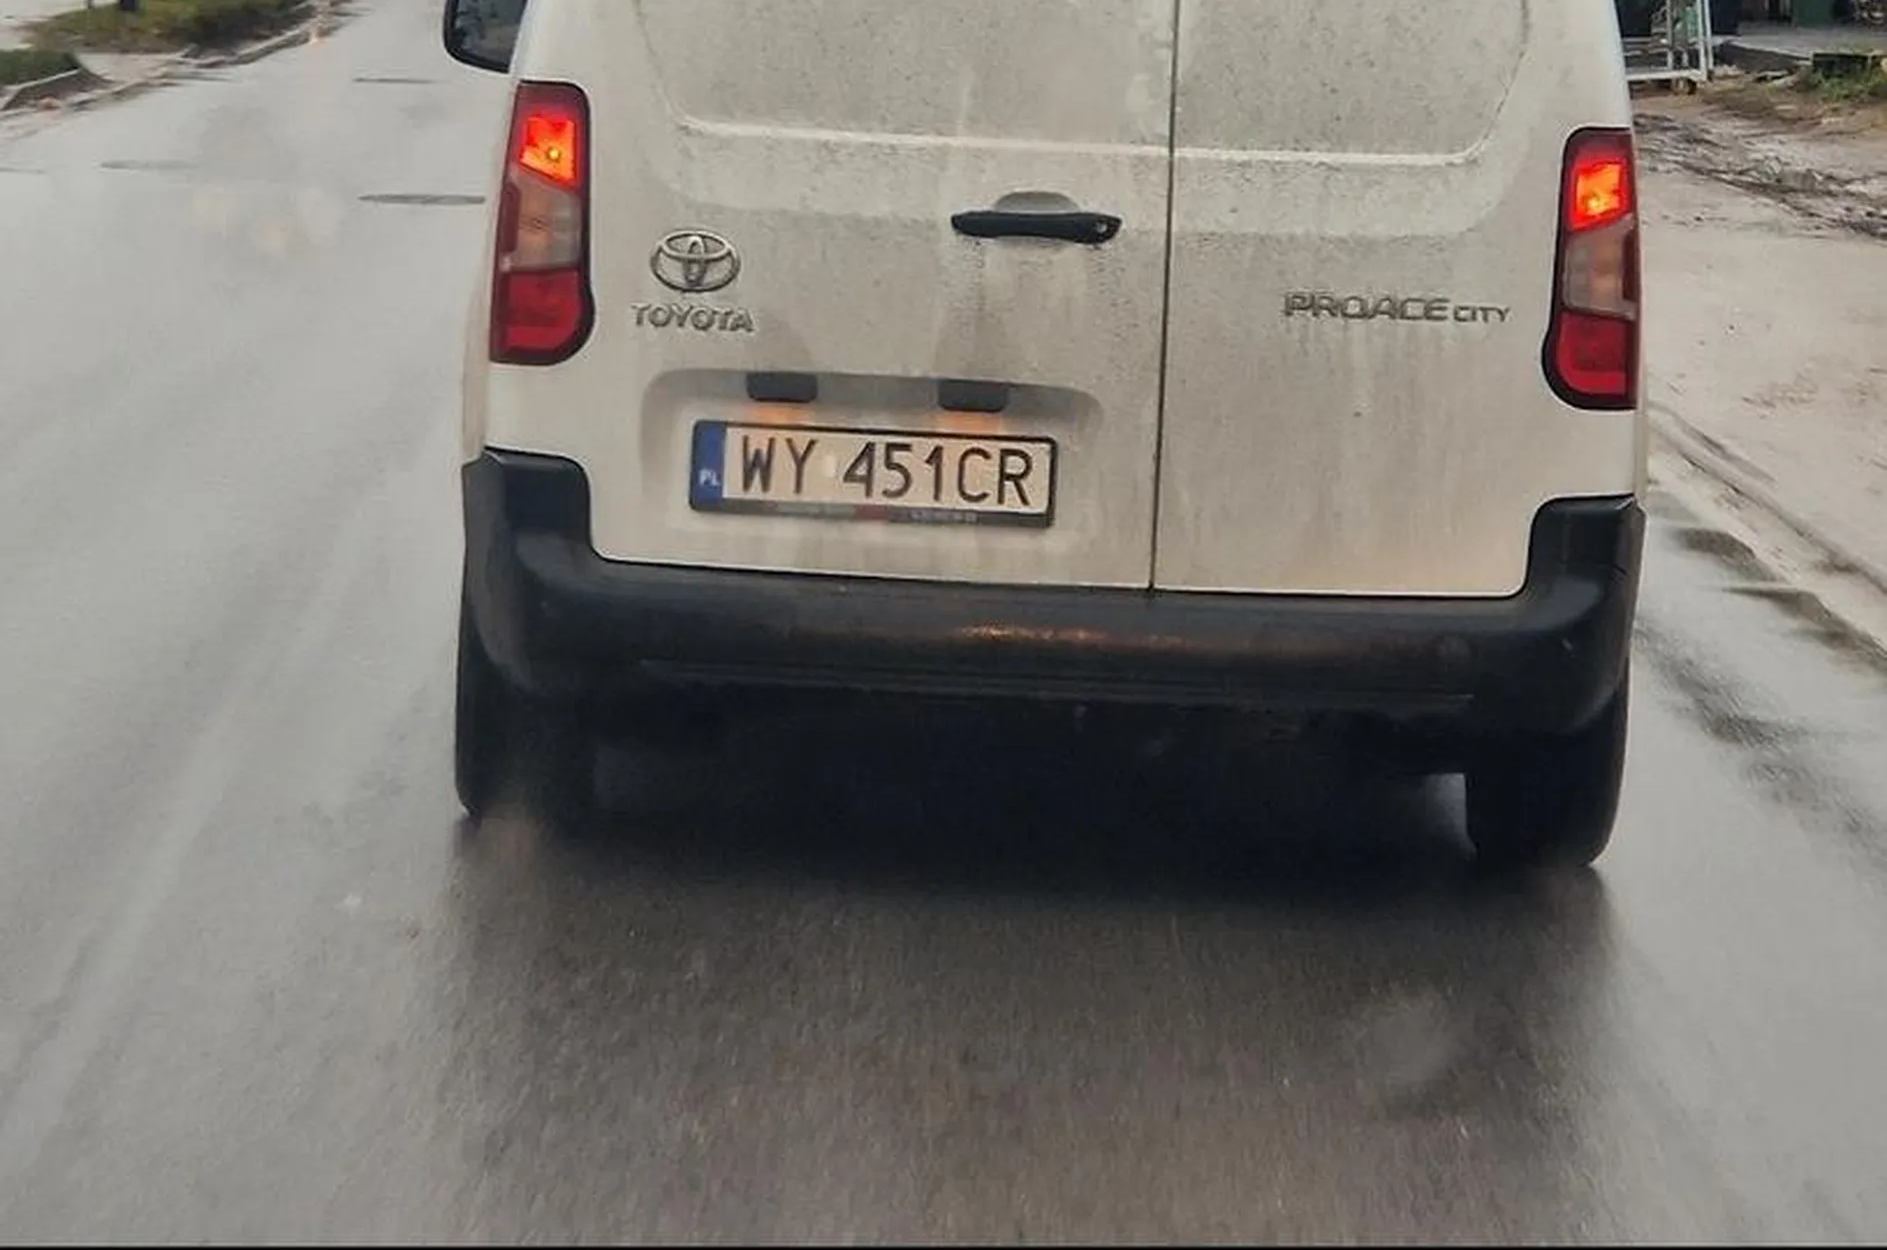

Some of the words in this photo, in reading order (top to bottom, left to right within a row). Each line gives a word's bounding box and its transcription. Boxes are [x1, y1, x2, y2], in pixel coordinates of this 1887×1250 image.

[630, 303, 755, 332] TOYOTA
[1283, 294, 1450, 321] PROACE
[1453, 306, 1511, 323] CITY
[700, 470, 720, 486] PL
[741, 435, 819, 495] WY
[842, 441, 1033, 506] 451CR
